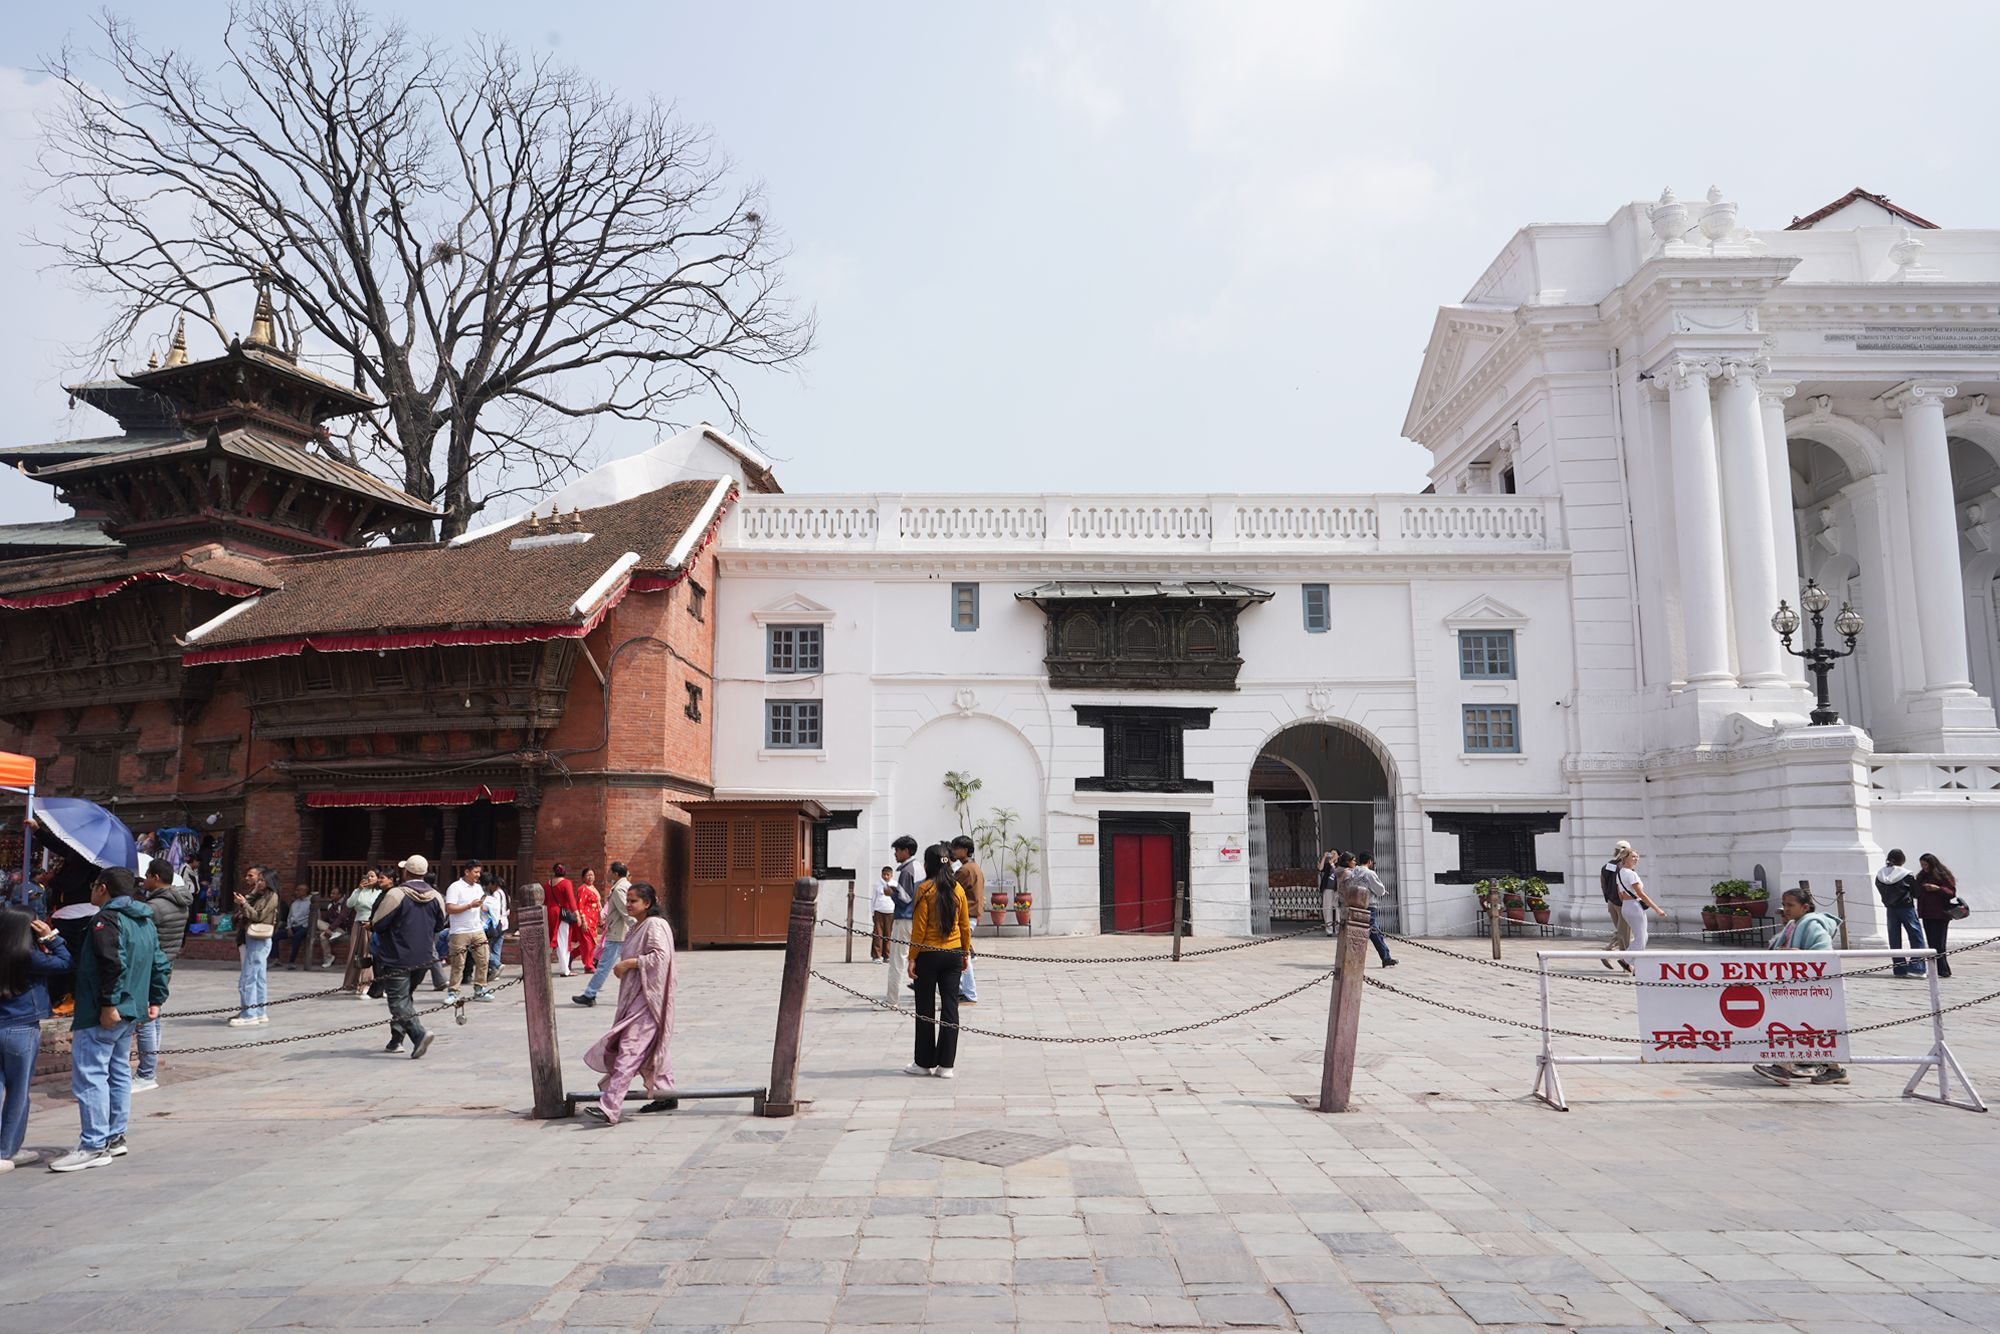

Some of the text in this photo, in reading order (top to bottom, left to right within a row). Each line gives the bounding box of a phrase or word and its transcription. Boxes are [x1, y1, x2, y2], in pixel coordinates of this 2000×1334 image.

[1659, 962, 1827, 981] NO ENTRY
[1652, 1022, 1838, 1051] प्रवेश निषेध
